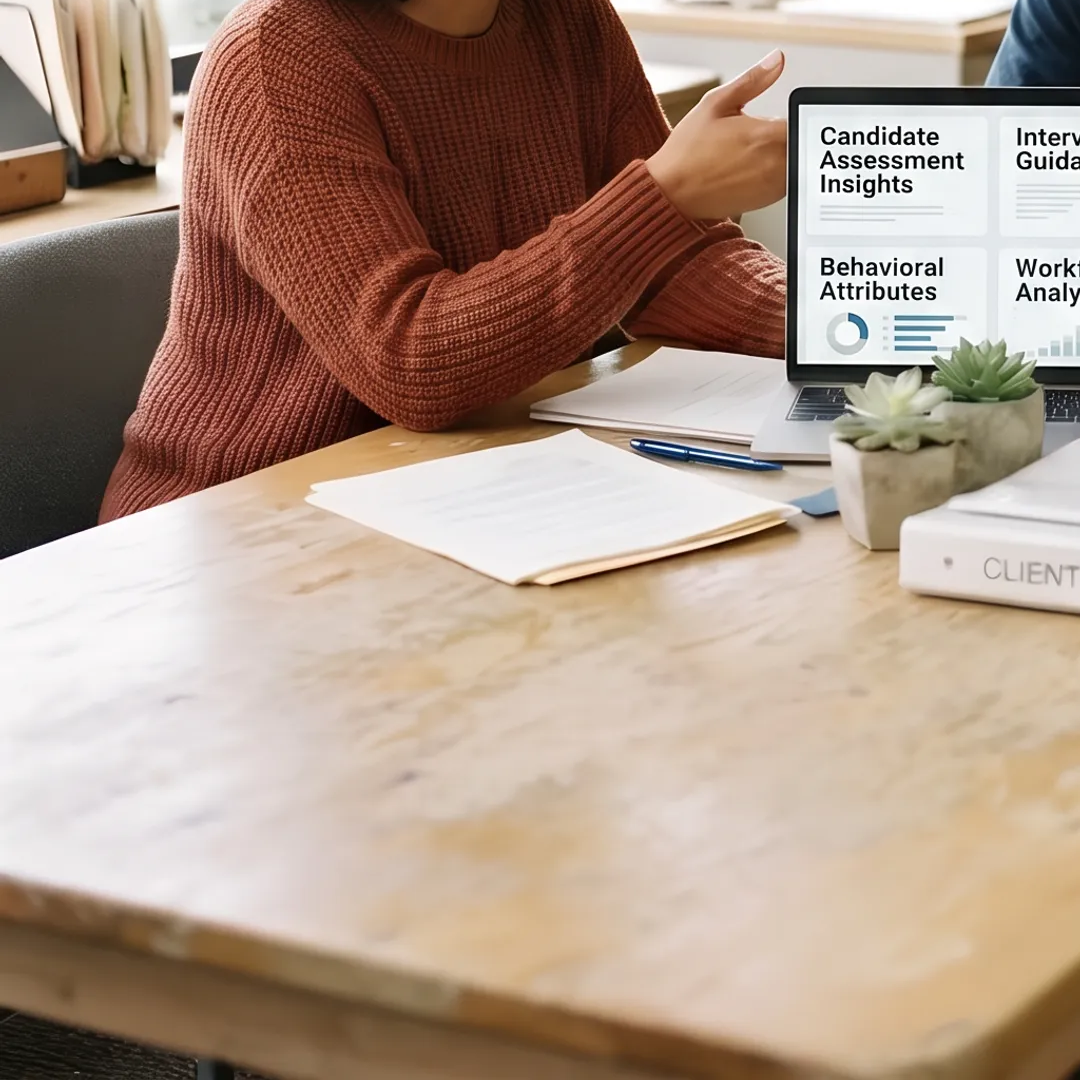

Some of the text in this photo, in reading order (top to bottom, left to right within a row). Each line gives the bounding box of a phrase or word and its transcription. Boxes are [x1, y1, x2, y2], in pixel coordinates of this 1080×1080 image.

[820, 125, 940, 146] Candidate
[819, 149, 965, 171] Assessment
[820, 173, 914, 199] Insights
[820, 256, 944, 277] Behavioral
[819, 280, 937, 302] Attributes
[983, 557, 1080, 588] CLIENT
